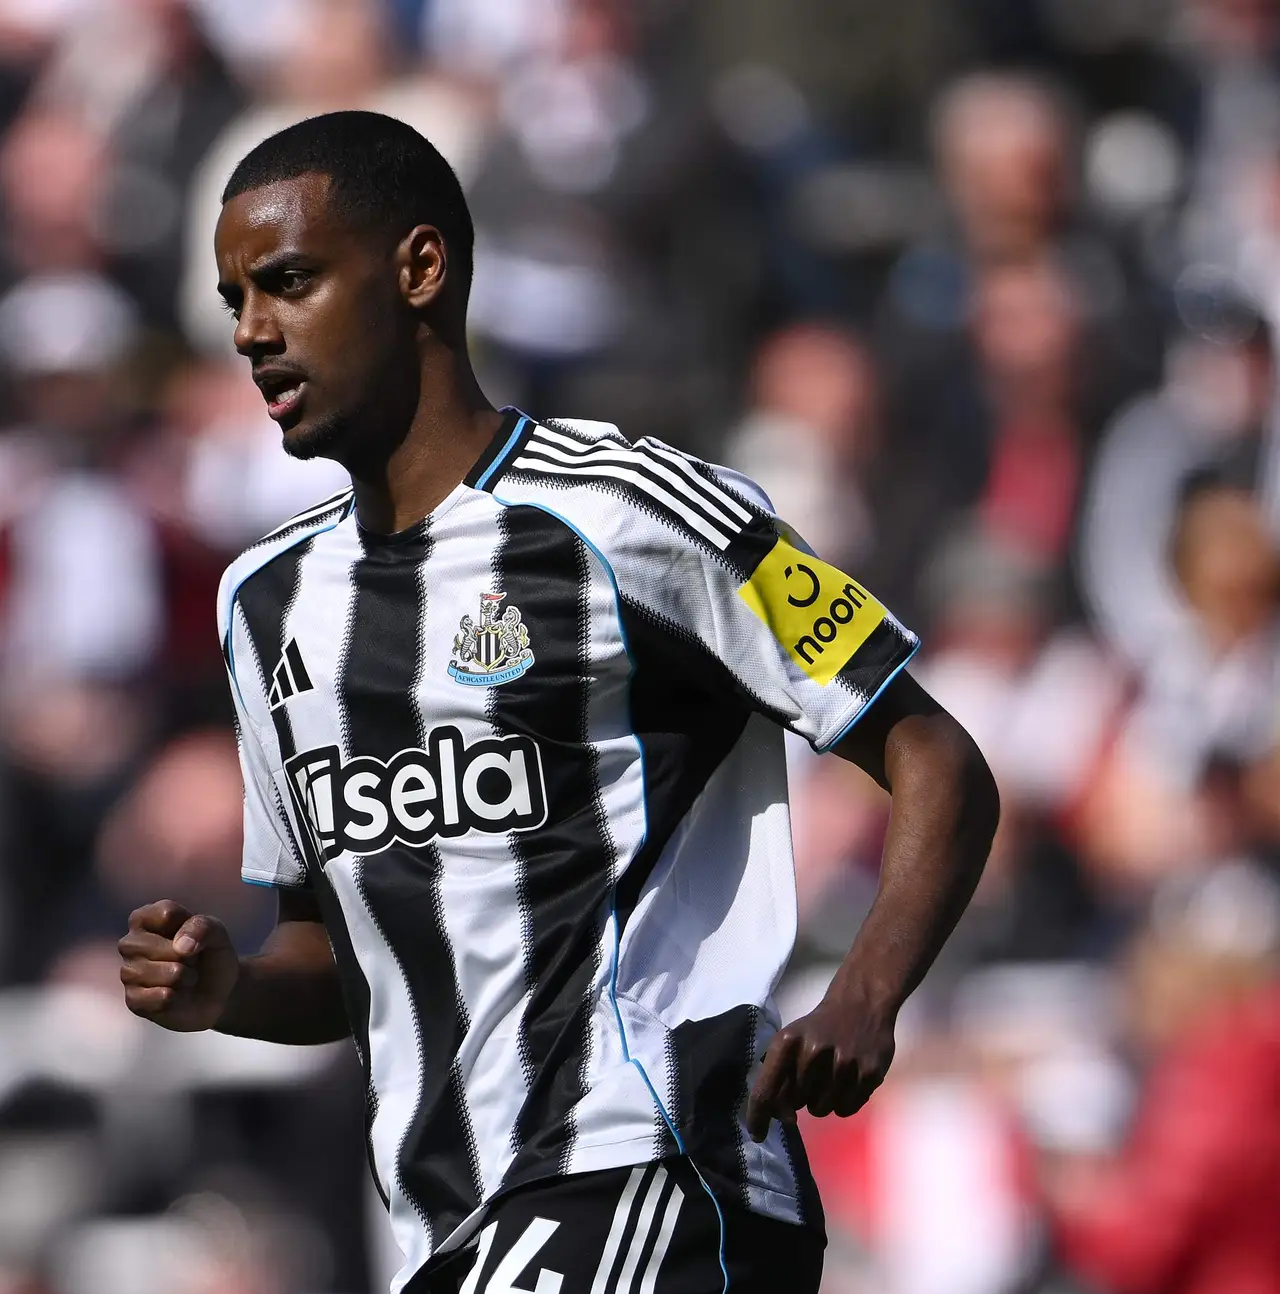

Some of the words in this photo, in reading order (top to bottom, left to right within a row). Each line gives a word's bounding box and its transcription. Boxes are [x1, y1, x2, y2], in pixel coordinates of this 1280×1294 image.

[794, 583, 867, 665] noon
[458, 674, 495, 683] NEWCASTLE
[495, 667, 521, 681] UNITED
